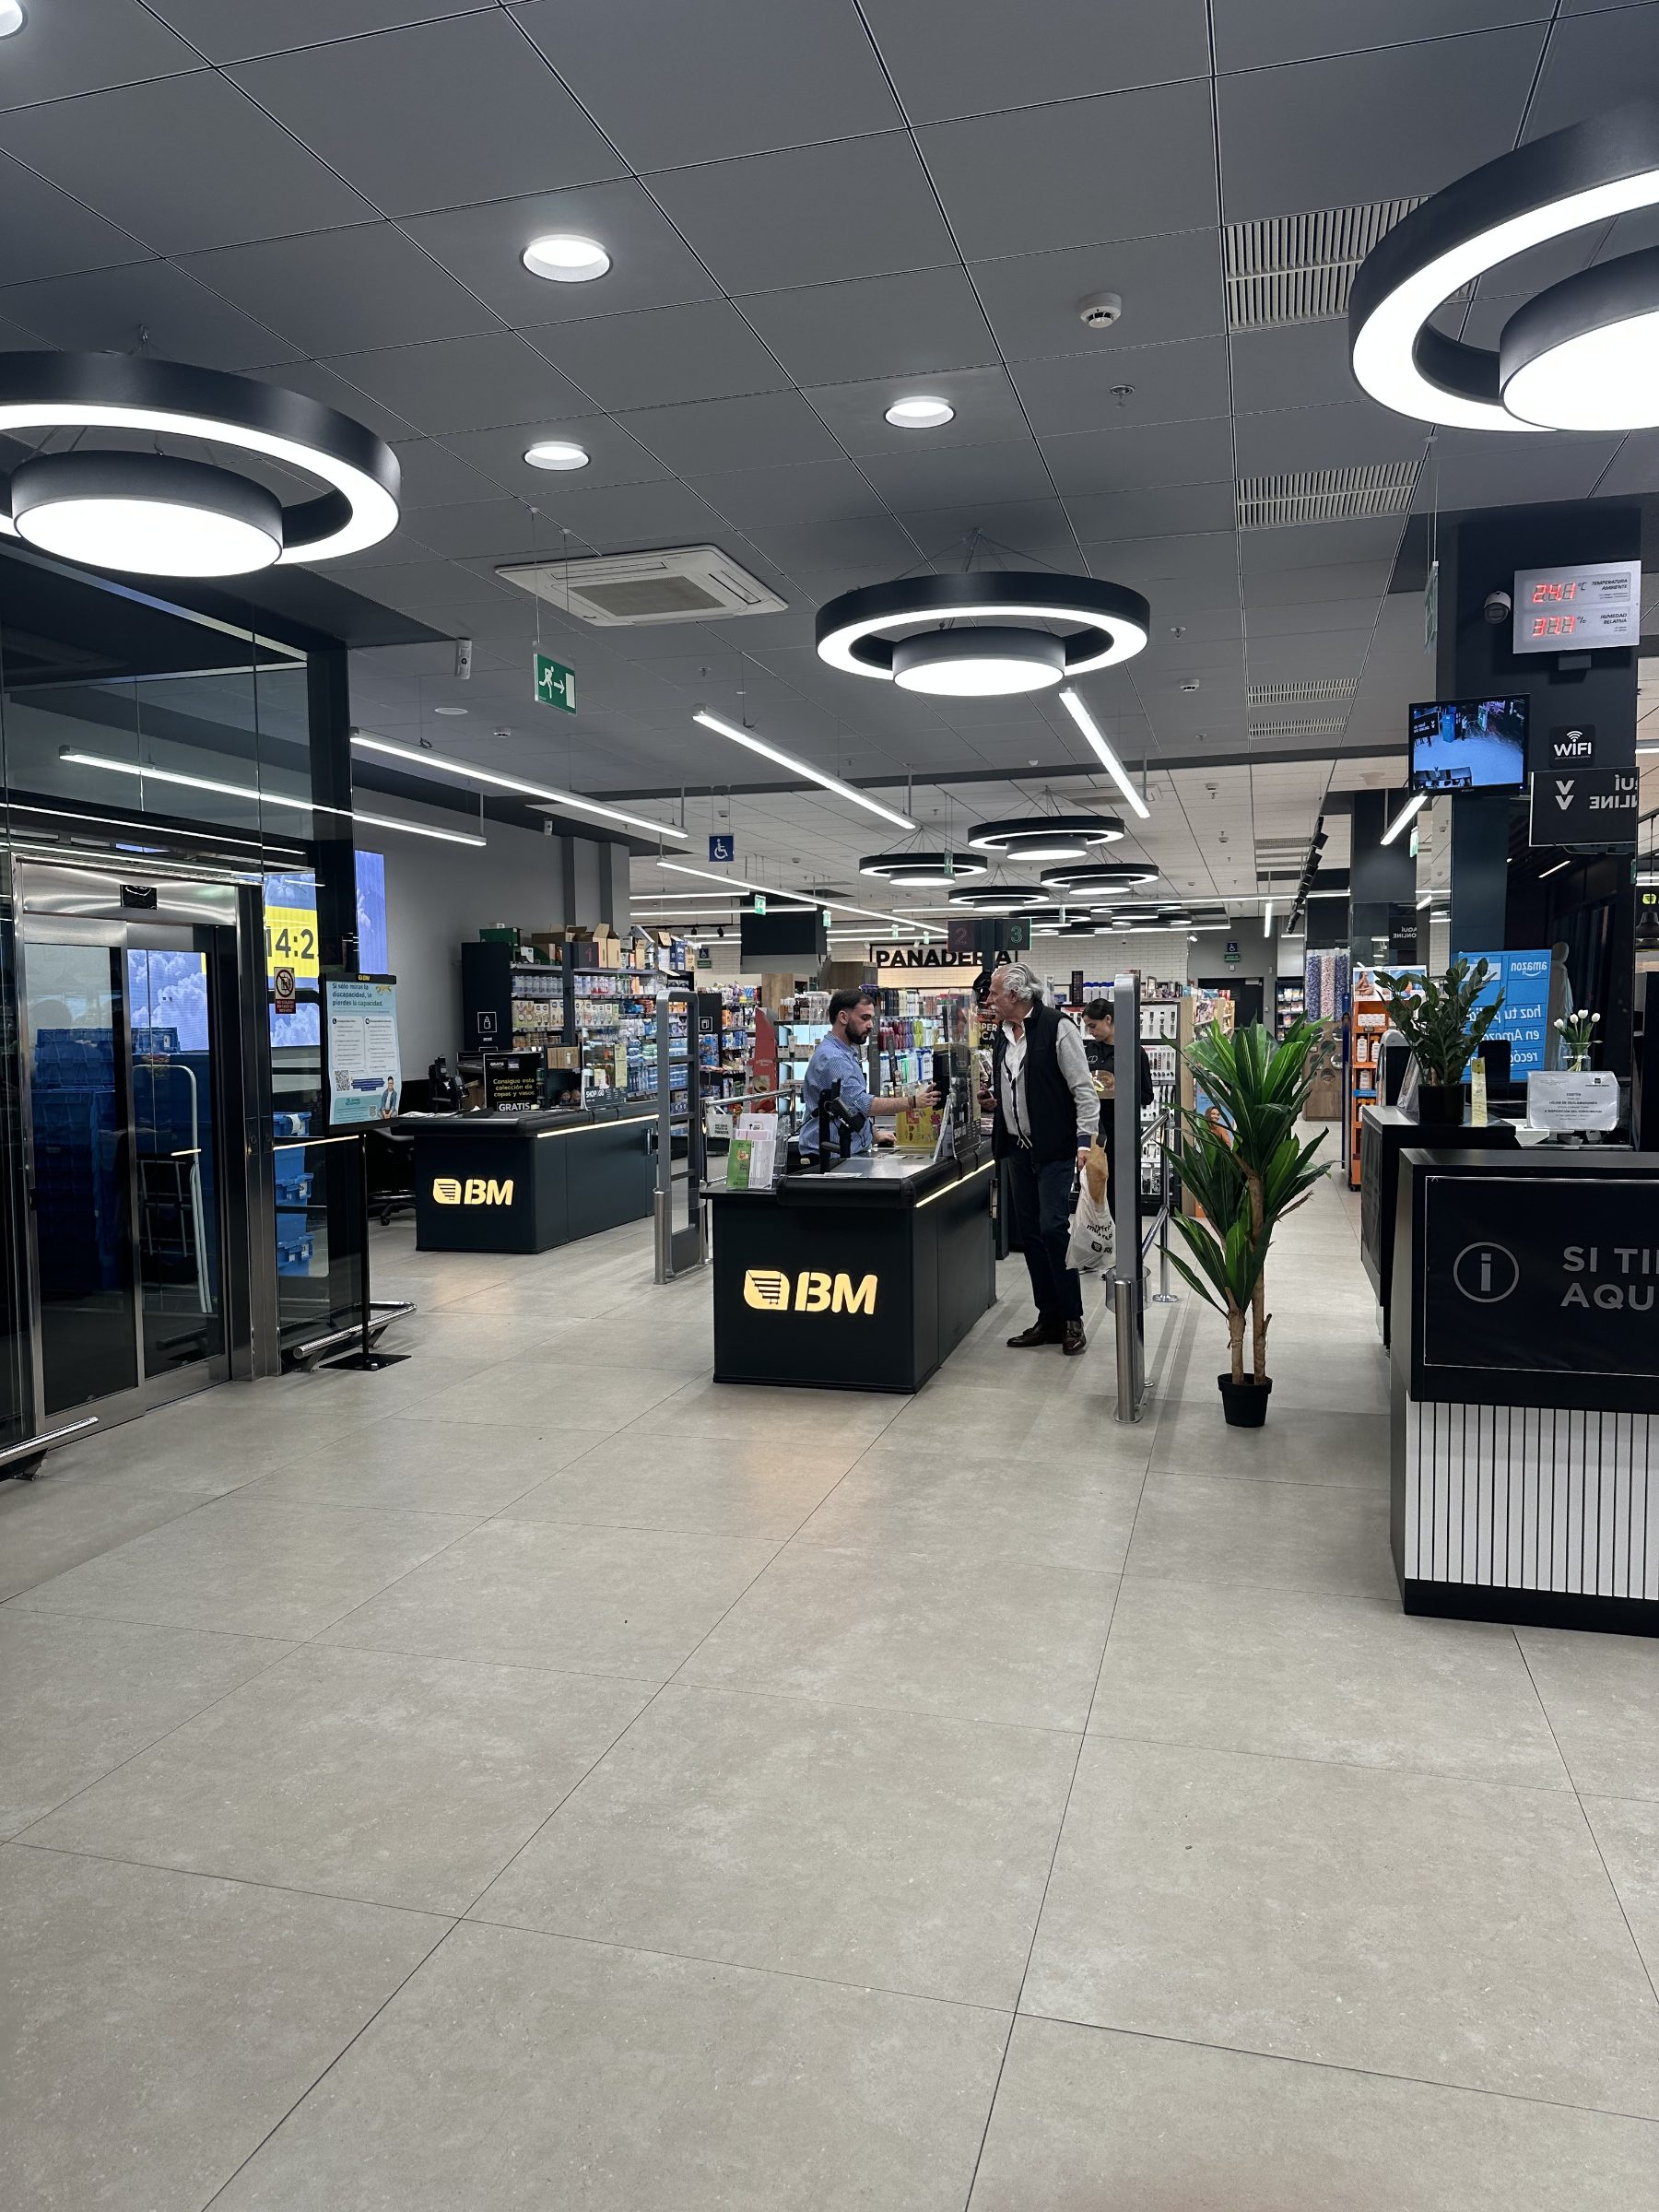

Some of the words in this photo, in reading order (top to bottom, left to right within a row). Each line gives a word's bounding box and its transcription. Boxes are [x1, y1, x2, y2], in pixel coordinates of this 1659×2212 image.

[1592, 578, 1628, 586] TEMPERATURA
[955, 927, 967, 945] 2
[1010, 925, 1023, 944] 3
[877, 949, 1012, 967] PANADERA
[499, 1102, 531, 1112] GRATIS
[464, 1179, 514, 1206] BM
[1562, 1246, 1598, 1273] SI
[1614, 1248, 1659, 1275] TI
[794, 1271, 878, 1315] BM
